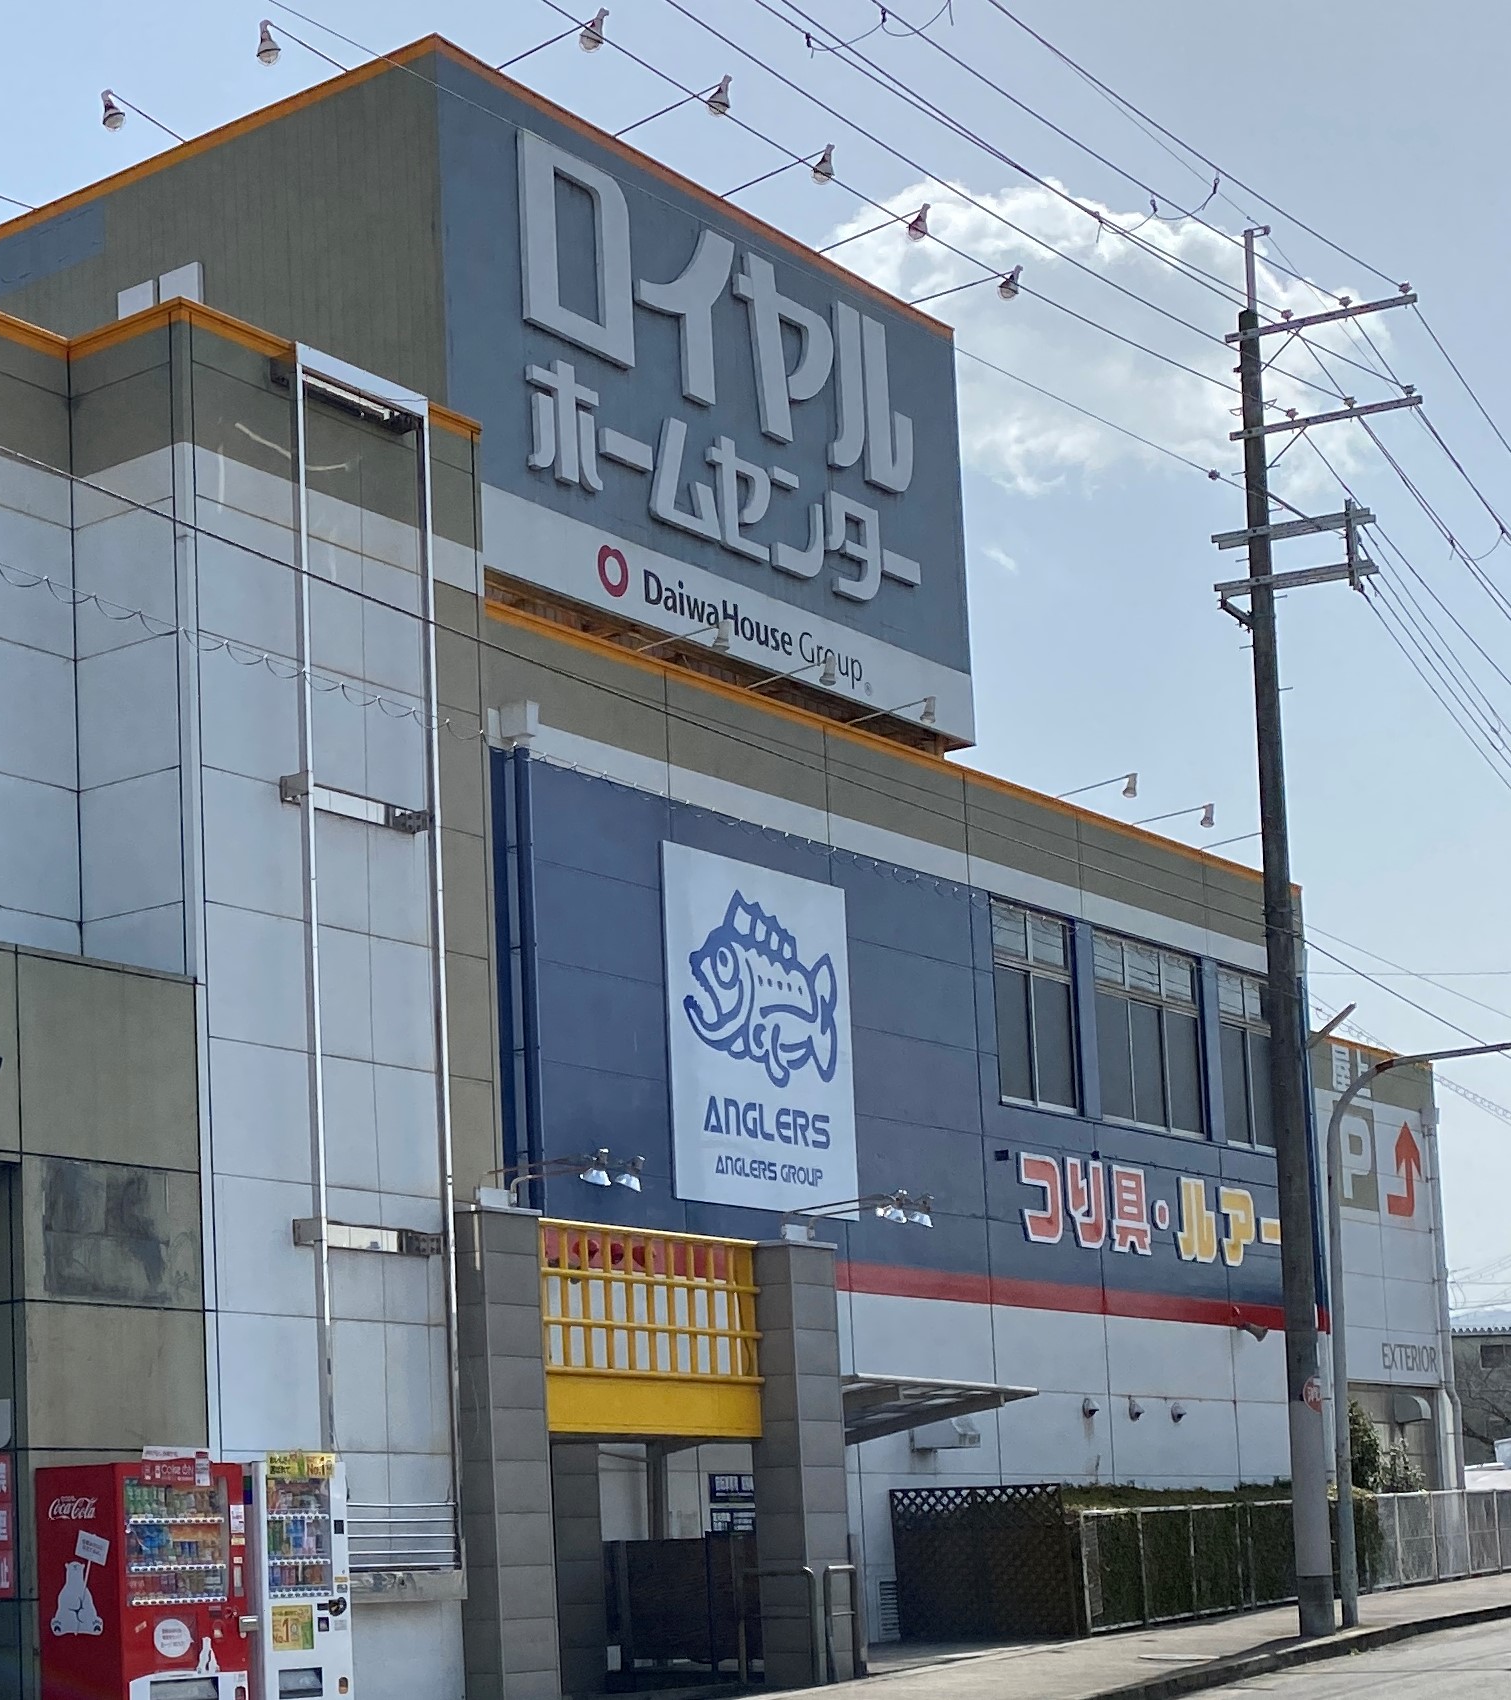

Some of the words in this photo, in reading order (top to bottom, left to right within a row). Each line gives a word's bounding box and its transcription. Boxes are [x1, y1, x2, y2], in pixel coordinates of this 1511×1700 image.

[516, 127, 914, 494] ロイヤル
[525, 358, 922, 602] ホームセンター
[703, 1094, 831, 1150] ANGLERS
[1339, 1114, 1373, 1200] P
[715, 1154, 778, 1182] ANGLERS
[781, 1163, 823, 1188] GROUP
[1381, 1342, 1438, 1373] EXTERIOR
